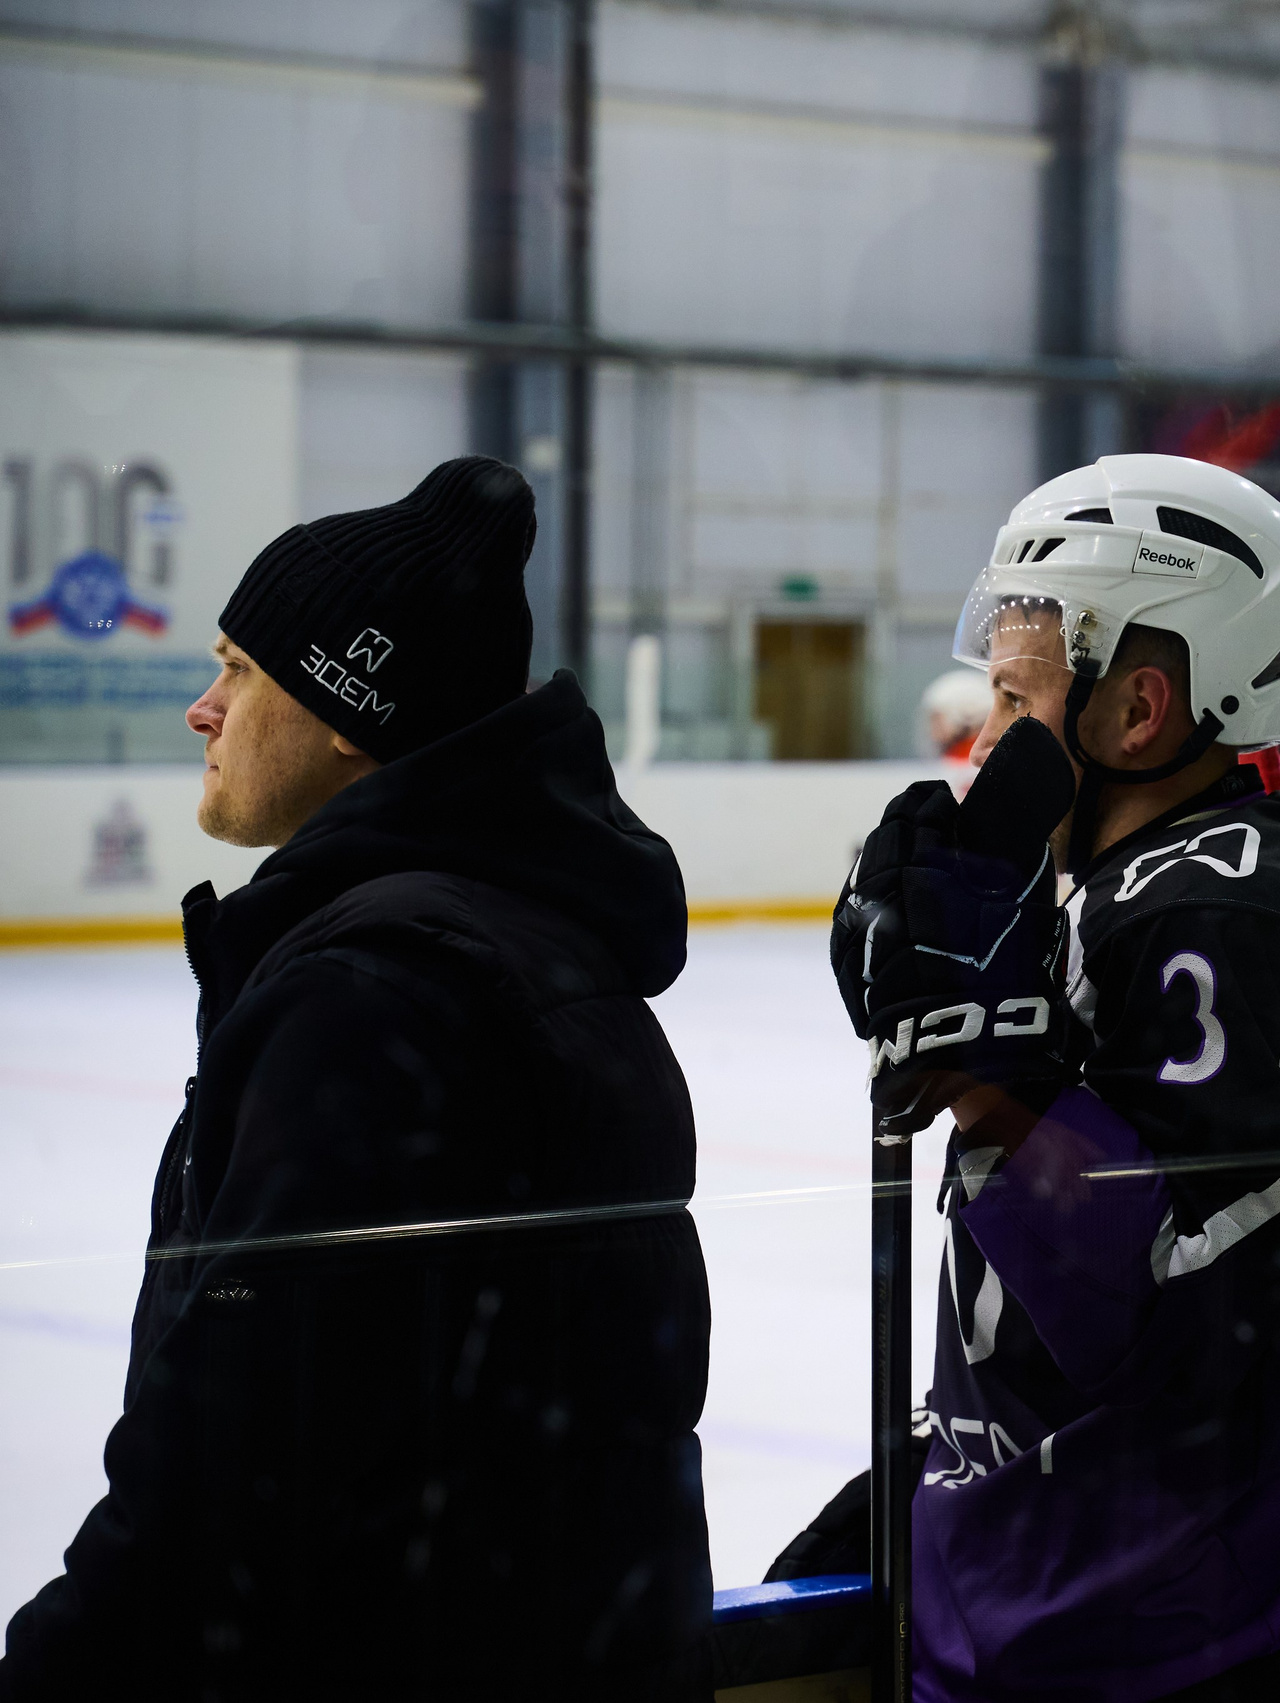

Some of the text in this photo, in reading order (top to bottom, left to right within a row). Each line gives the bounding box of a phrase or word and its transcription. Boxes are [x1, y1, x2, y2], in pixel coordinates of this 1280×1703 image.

[1139, 547, 1196, 571] Reebok
[300, 643, 396, 726] ЭДЕМ
[866, 996, 1051, 1081] CCM
[1157, 949, 1228, 1085] 3
